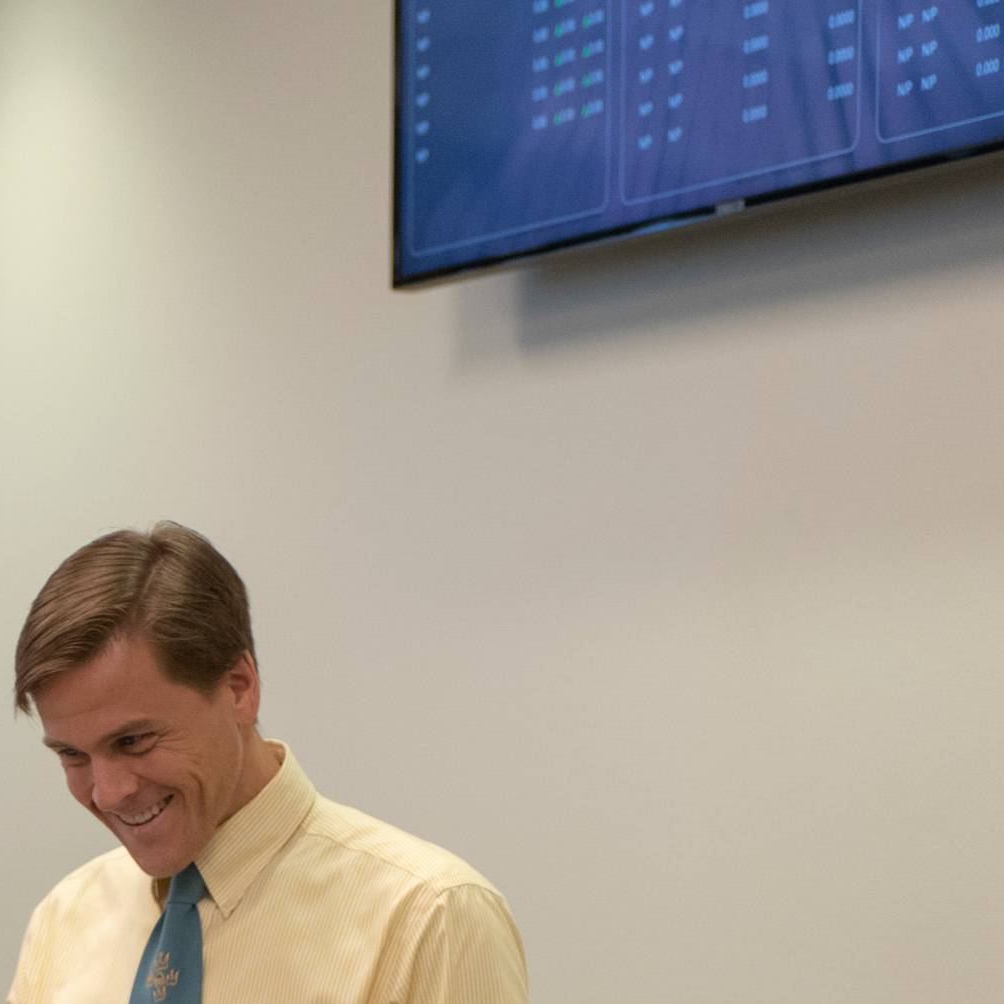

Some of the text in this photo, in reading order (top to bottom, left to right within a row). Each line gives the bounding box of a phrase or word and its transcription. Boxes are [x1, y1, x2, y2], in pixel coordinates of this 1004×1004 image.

[922, 6, 938, 23] NP
[921, 40, 938, 56] NP
[921, 74, 937, 90] NP
